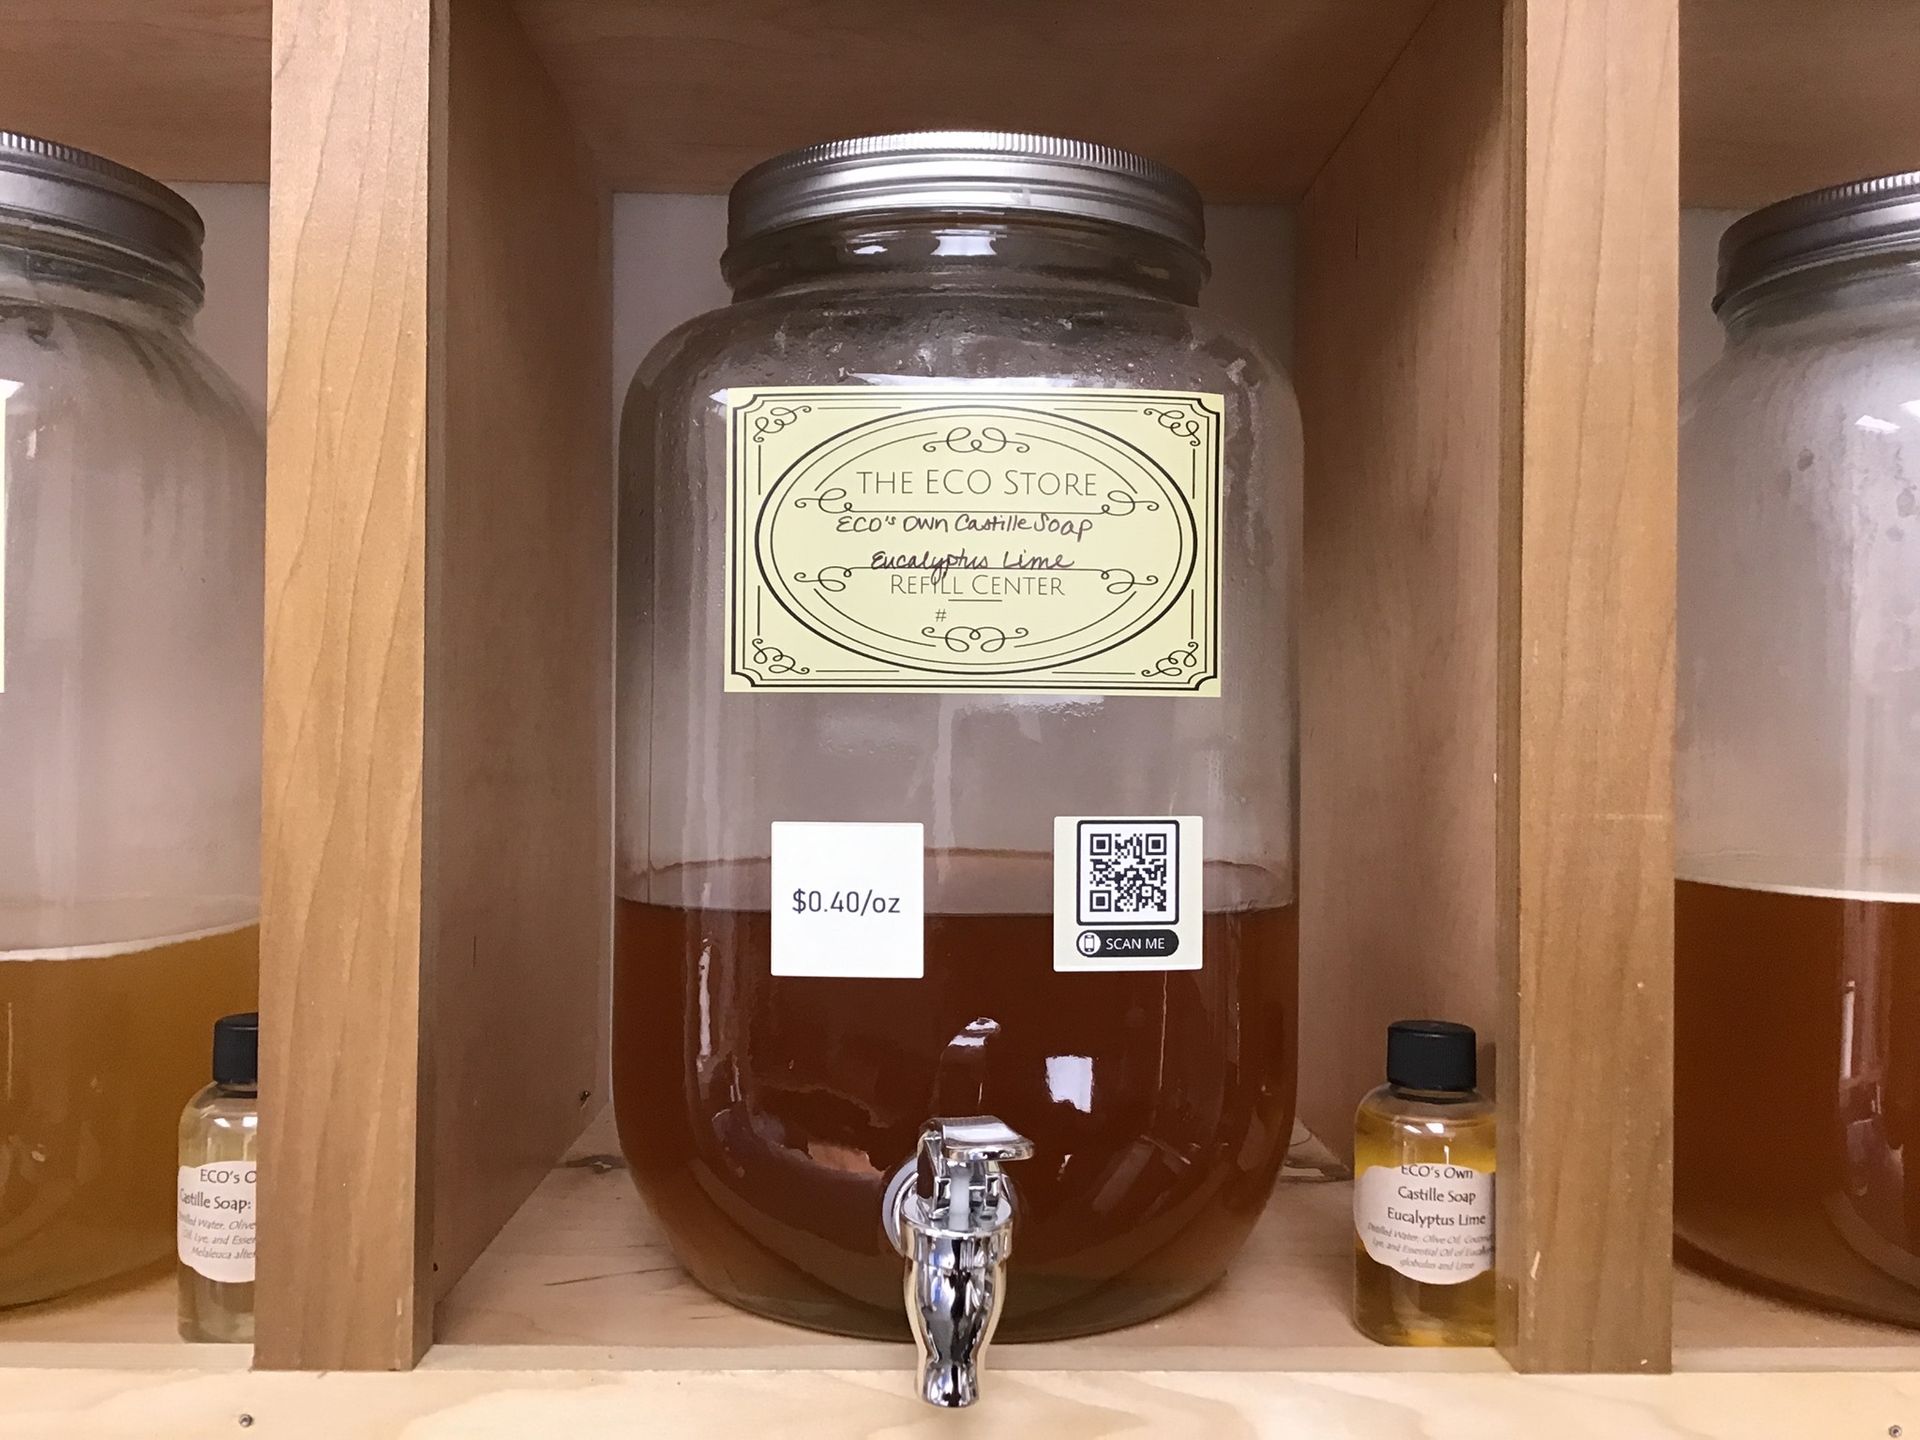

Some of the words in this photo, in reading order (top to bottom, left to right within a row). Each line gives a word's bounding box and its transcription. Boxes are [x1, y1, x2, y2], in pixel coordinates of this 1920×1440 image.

[856, 470, 914, 496] THE
[926, 469, 992, 497] ECO
[1003, 469, 1098, 498] STORE
[902, 516, 949, 535] Own
[953, 513, 1030, 533] Castille
[1031, 513, 1094, 543] Soap
[870, 548, 988, 586] Eucalyptus
[1002, 549, 1075, 570] Lime
[890, 573, 964, 596] REFILL
[971, 575, 1066, 597] CENTER
[792, 887, 901, 916] $0.40/oz
[1104, 936, 1142, 951] SCAN
[1144, 937, 1166, 951] ME
[200, 1168, 240, 1184] ECO's
[1401, 1165, 1440, 1178] ECO's
[1444, 1167, 1473, 1180] Own
[214, 1195, 252, 1214] Soap:
[1398, 1186, 1445, 1203] Castille
[1448, 1191, 1476, 1205] Soap
[1387, 1207, 1455, 1228] Eucalyptus
[1458, 1214, 1486, 1226] Lime
